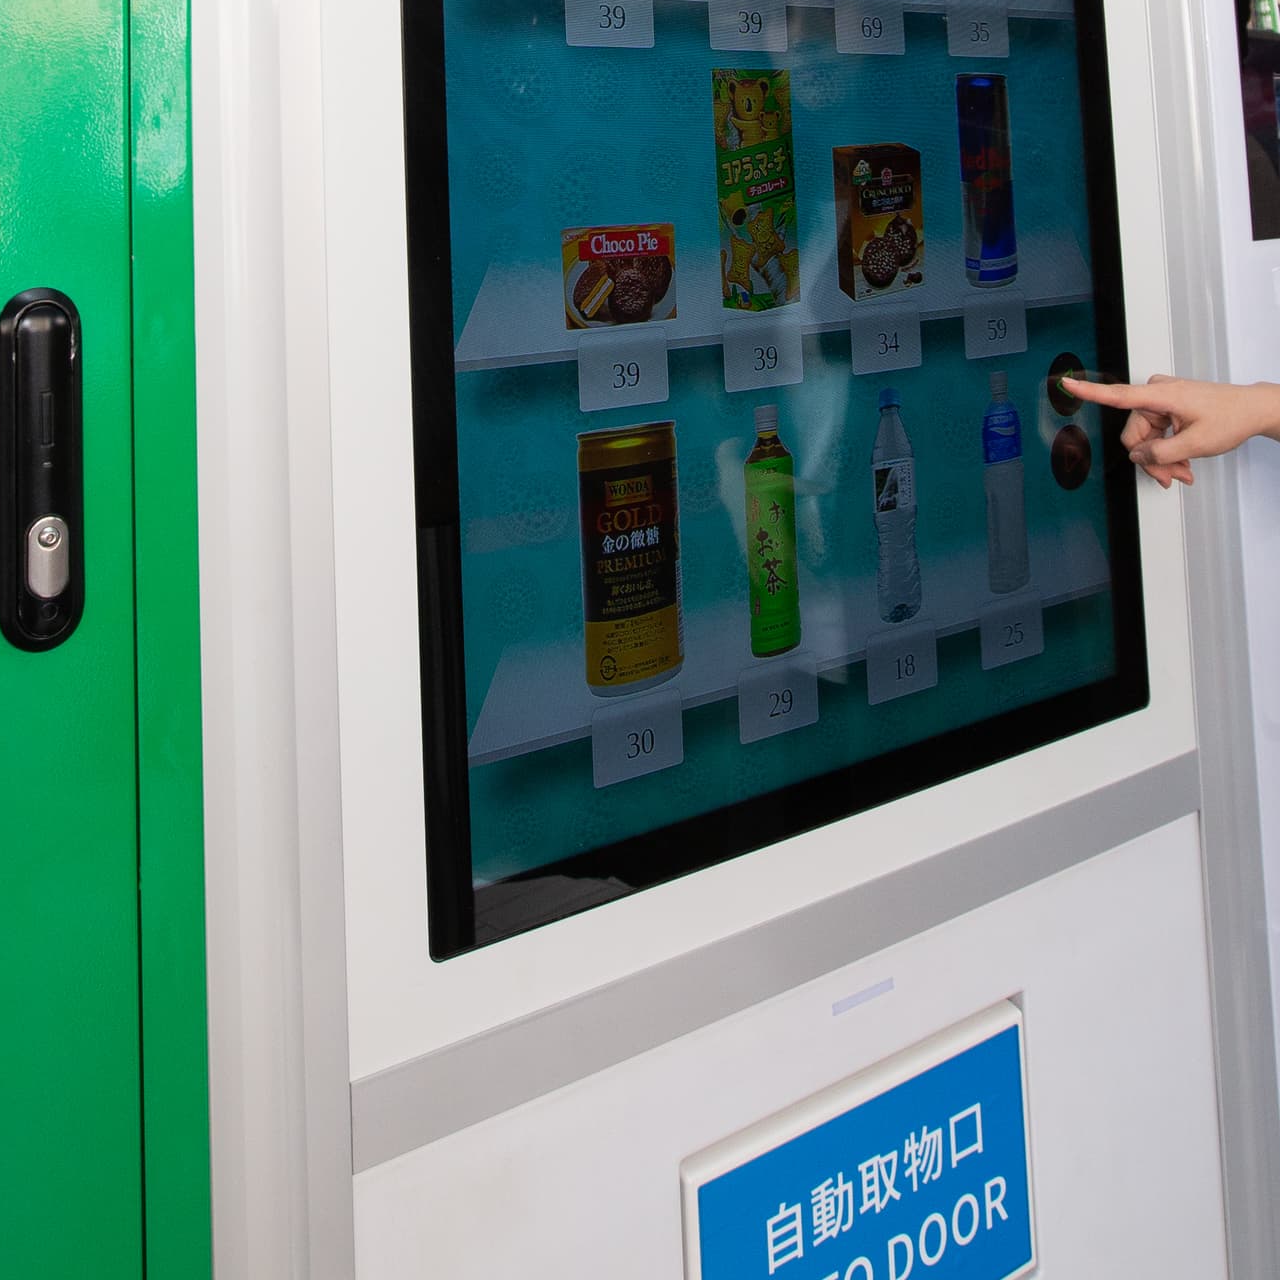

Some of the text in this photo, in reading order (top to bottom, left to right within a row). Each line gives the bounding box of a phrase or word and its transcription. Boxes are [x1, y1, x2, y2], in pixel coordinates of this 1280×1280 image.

[598, 4, 626, 29] 39
[738, 11, 763, 35] 39
[861, 16, 883, 39] 69
[969, 21, 990, 43] 35
[721, 147, 787, 186] コアラのマーチ
[748, 178, 787, 196] チョコレート
[591, 234, 635, 255] Choco
[637, 231, 659, 252] Pie
[987, 318, 1007, 342] 59
[877, 331, 900, 355] 34
[753, 346, 779, 372] 39
[612, 362, 640, 389] 39
[608, 475, 649, 497] WONDA
[596, 504, 664, 535] GOLD
[602, 526, 660, 554] 金の微糖
[596, 549, 667, 575] PREMIUM
[1002, 623, 1024, 647] 25
[895, 653, 916, 678] 18
[768, 689, 794, 717] 29
[626, 727, 655, 758] 30
[766, 1103, 984, 1275] 自動取物口
[887, 1176, 1009, 1280] DOOR
